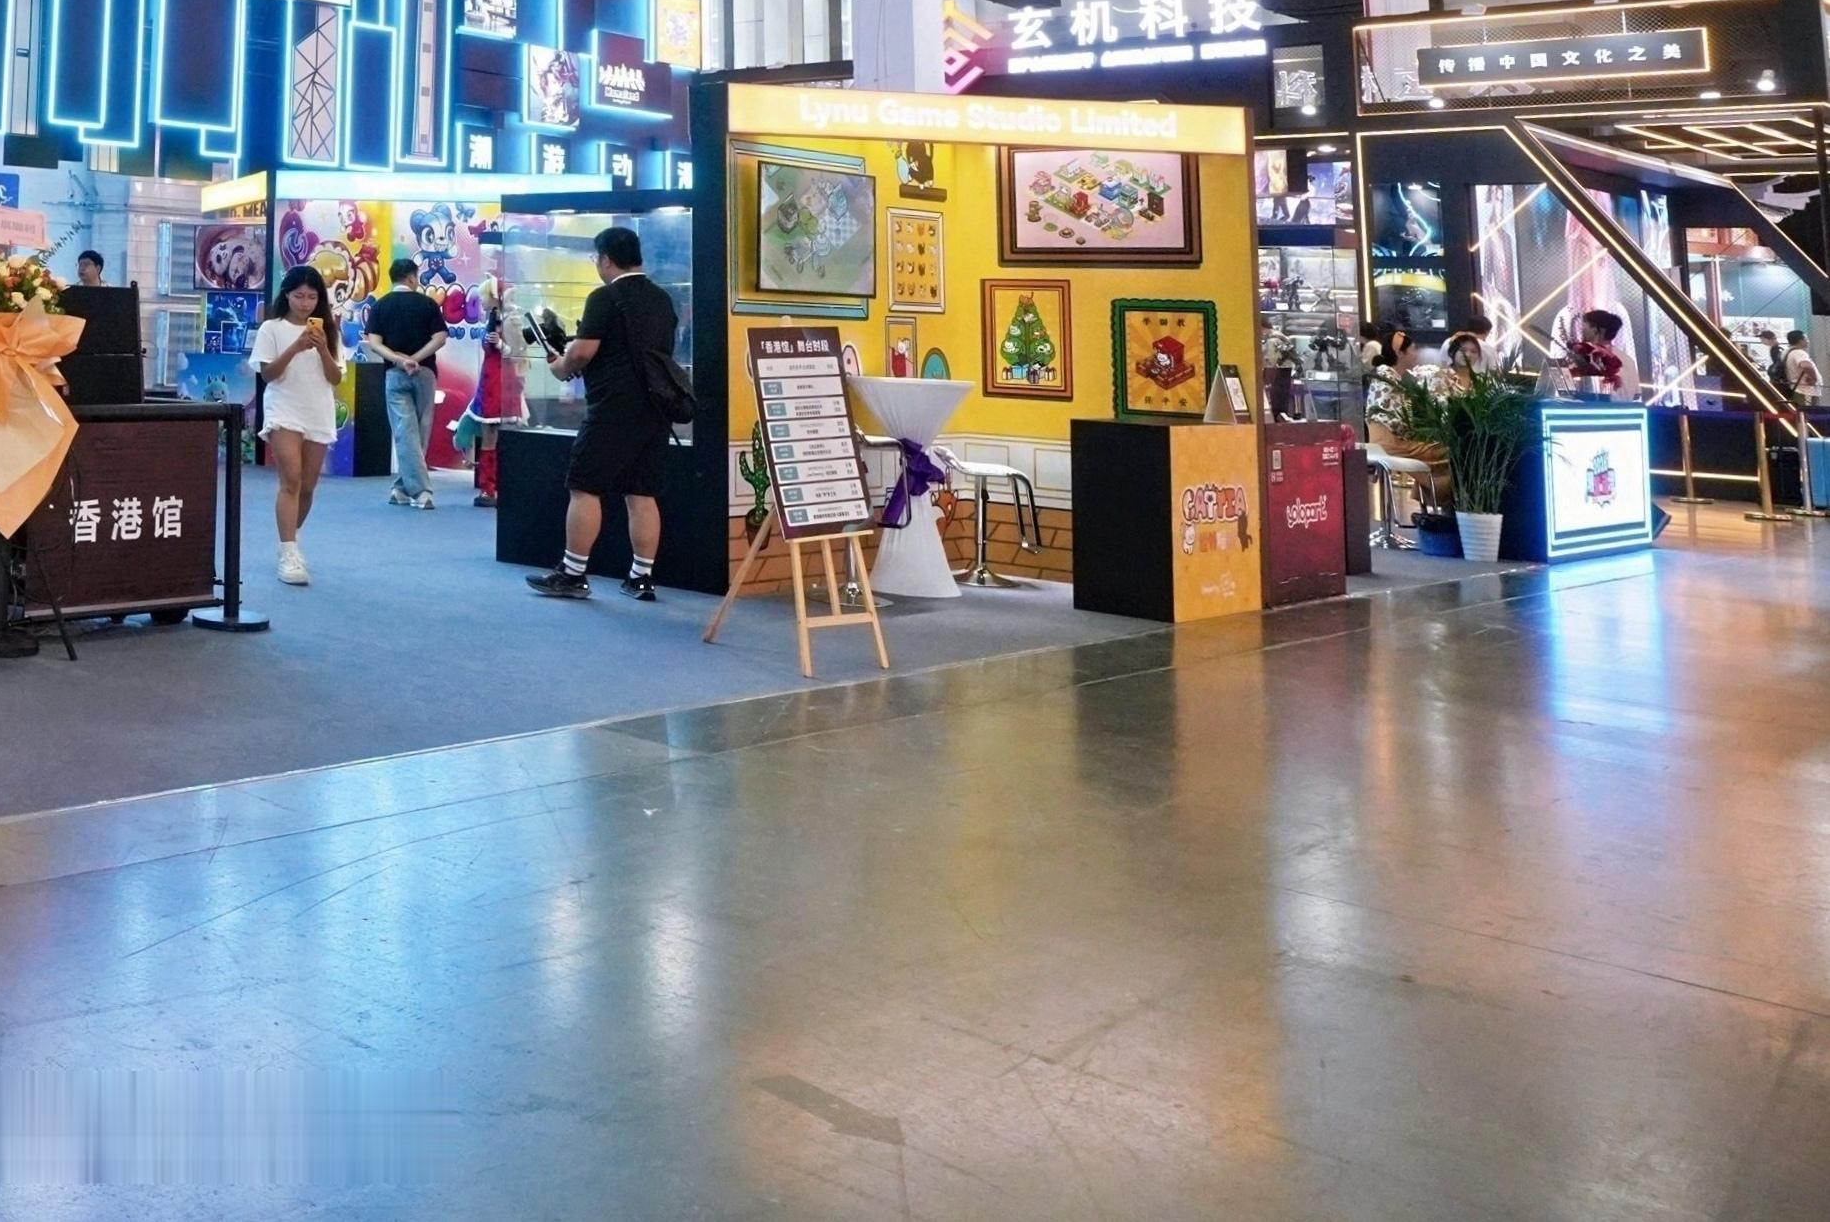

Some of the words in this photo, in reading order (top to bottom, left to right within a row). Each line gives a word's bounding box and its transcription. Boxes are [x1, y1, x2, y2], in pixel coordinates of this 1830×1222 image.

[1439, 43, 1682, 74] 传播中国文化之美
[877, 98, 960, 128] Game
[969, 103, 1062, 134] Studio
[1071, 109, 1177, 139] Limited
[69, 495, 183, 544] 香港馆
